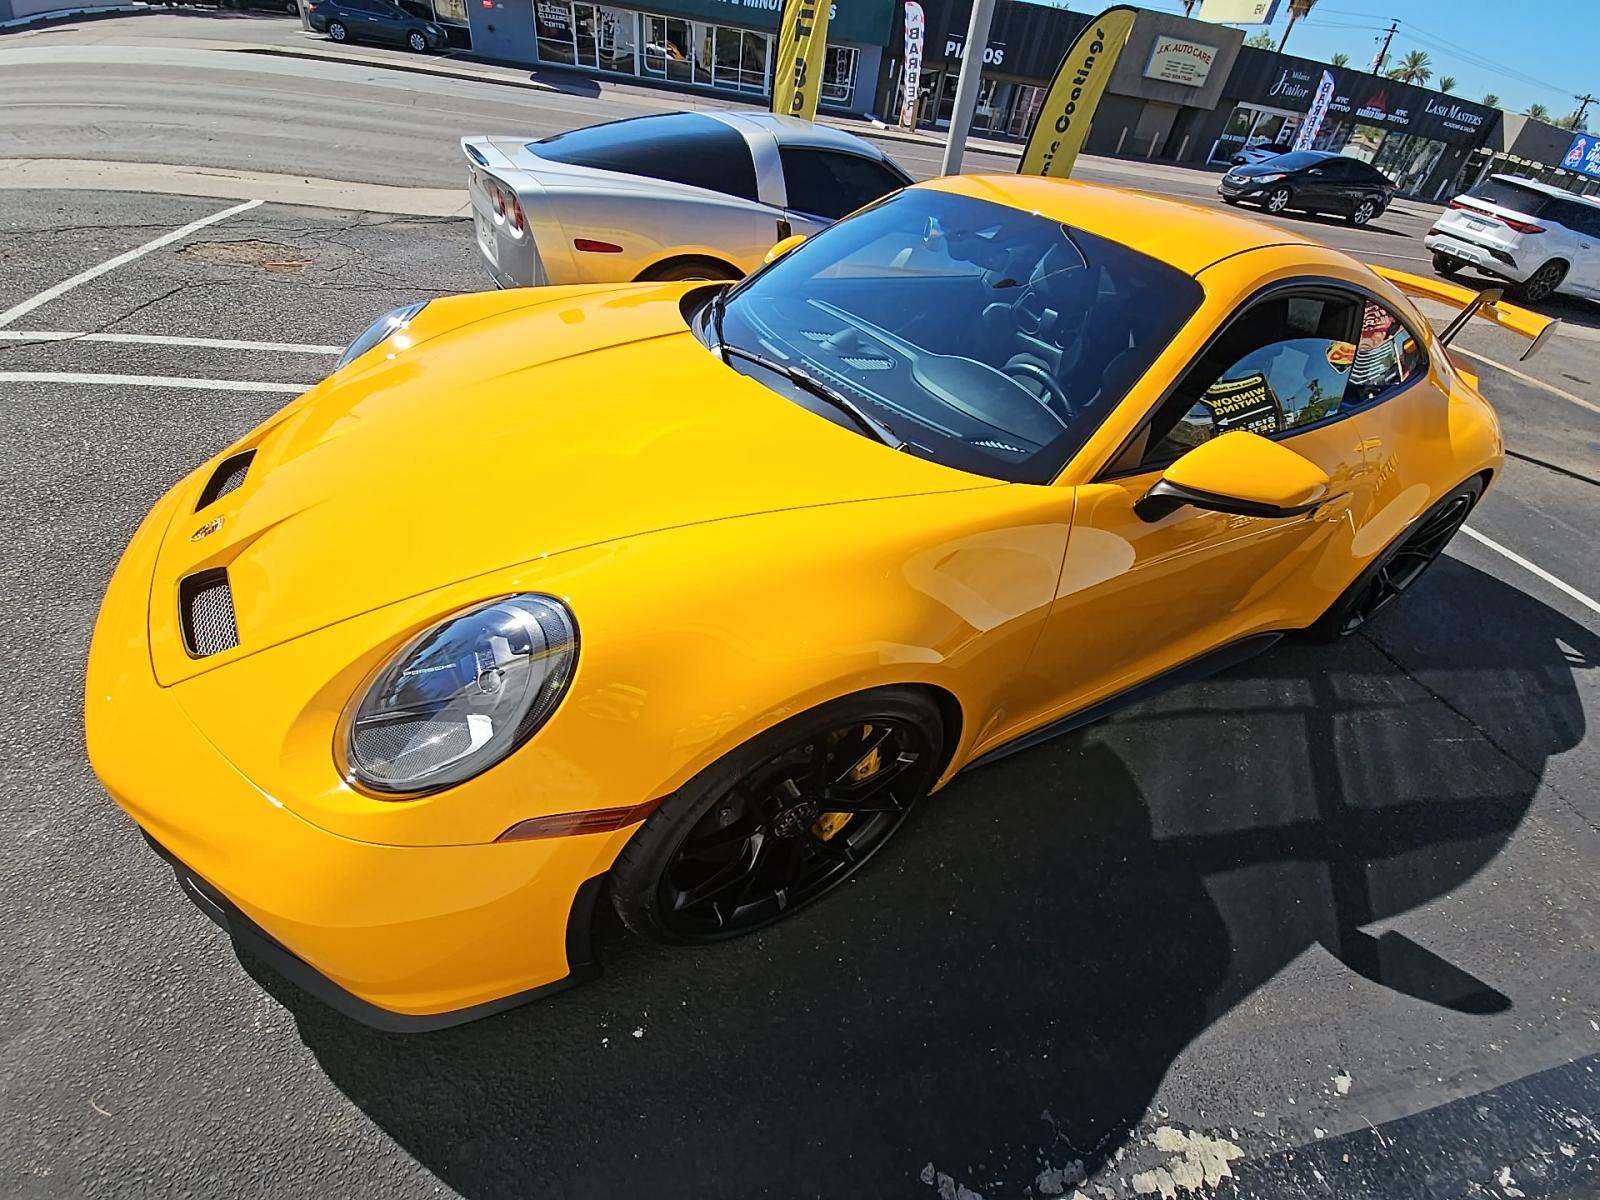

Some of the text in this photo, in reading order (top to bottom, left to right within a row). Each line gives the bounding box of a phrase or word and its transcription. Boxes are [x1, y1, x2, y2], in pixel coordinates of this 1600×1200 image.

[944, 40, 1004, 65] PIOS
[1172, 44, 1193, 54] AUTO
[1192, 48, 1212, 65] CARE
[1055, 28, 1105, 133] Coatings
[1281, 82, 1309, 98] Tailor
[402, 662, 457, 677] PORSCHE
